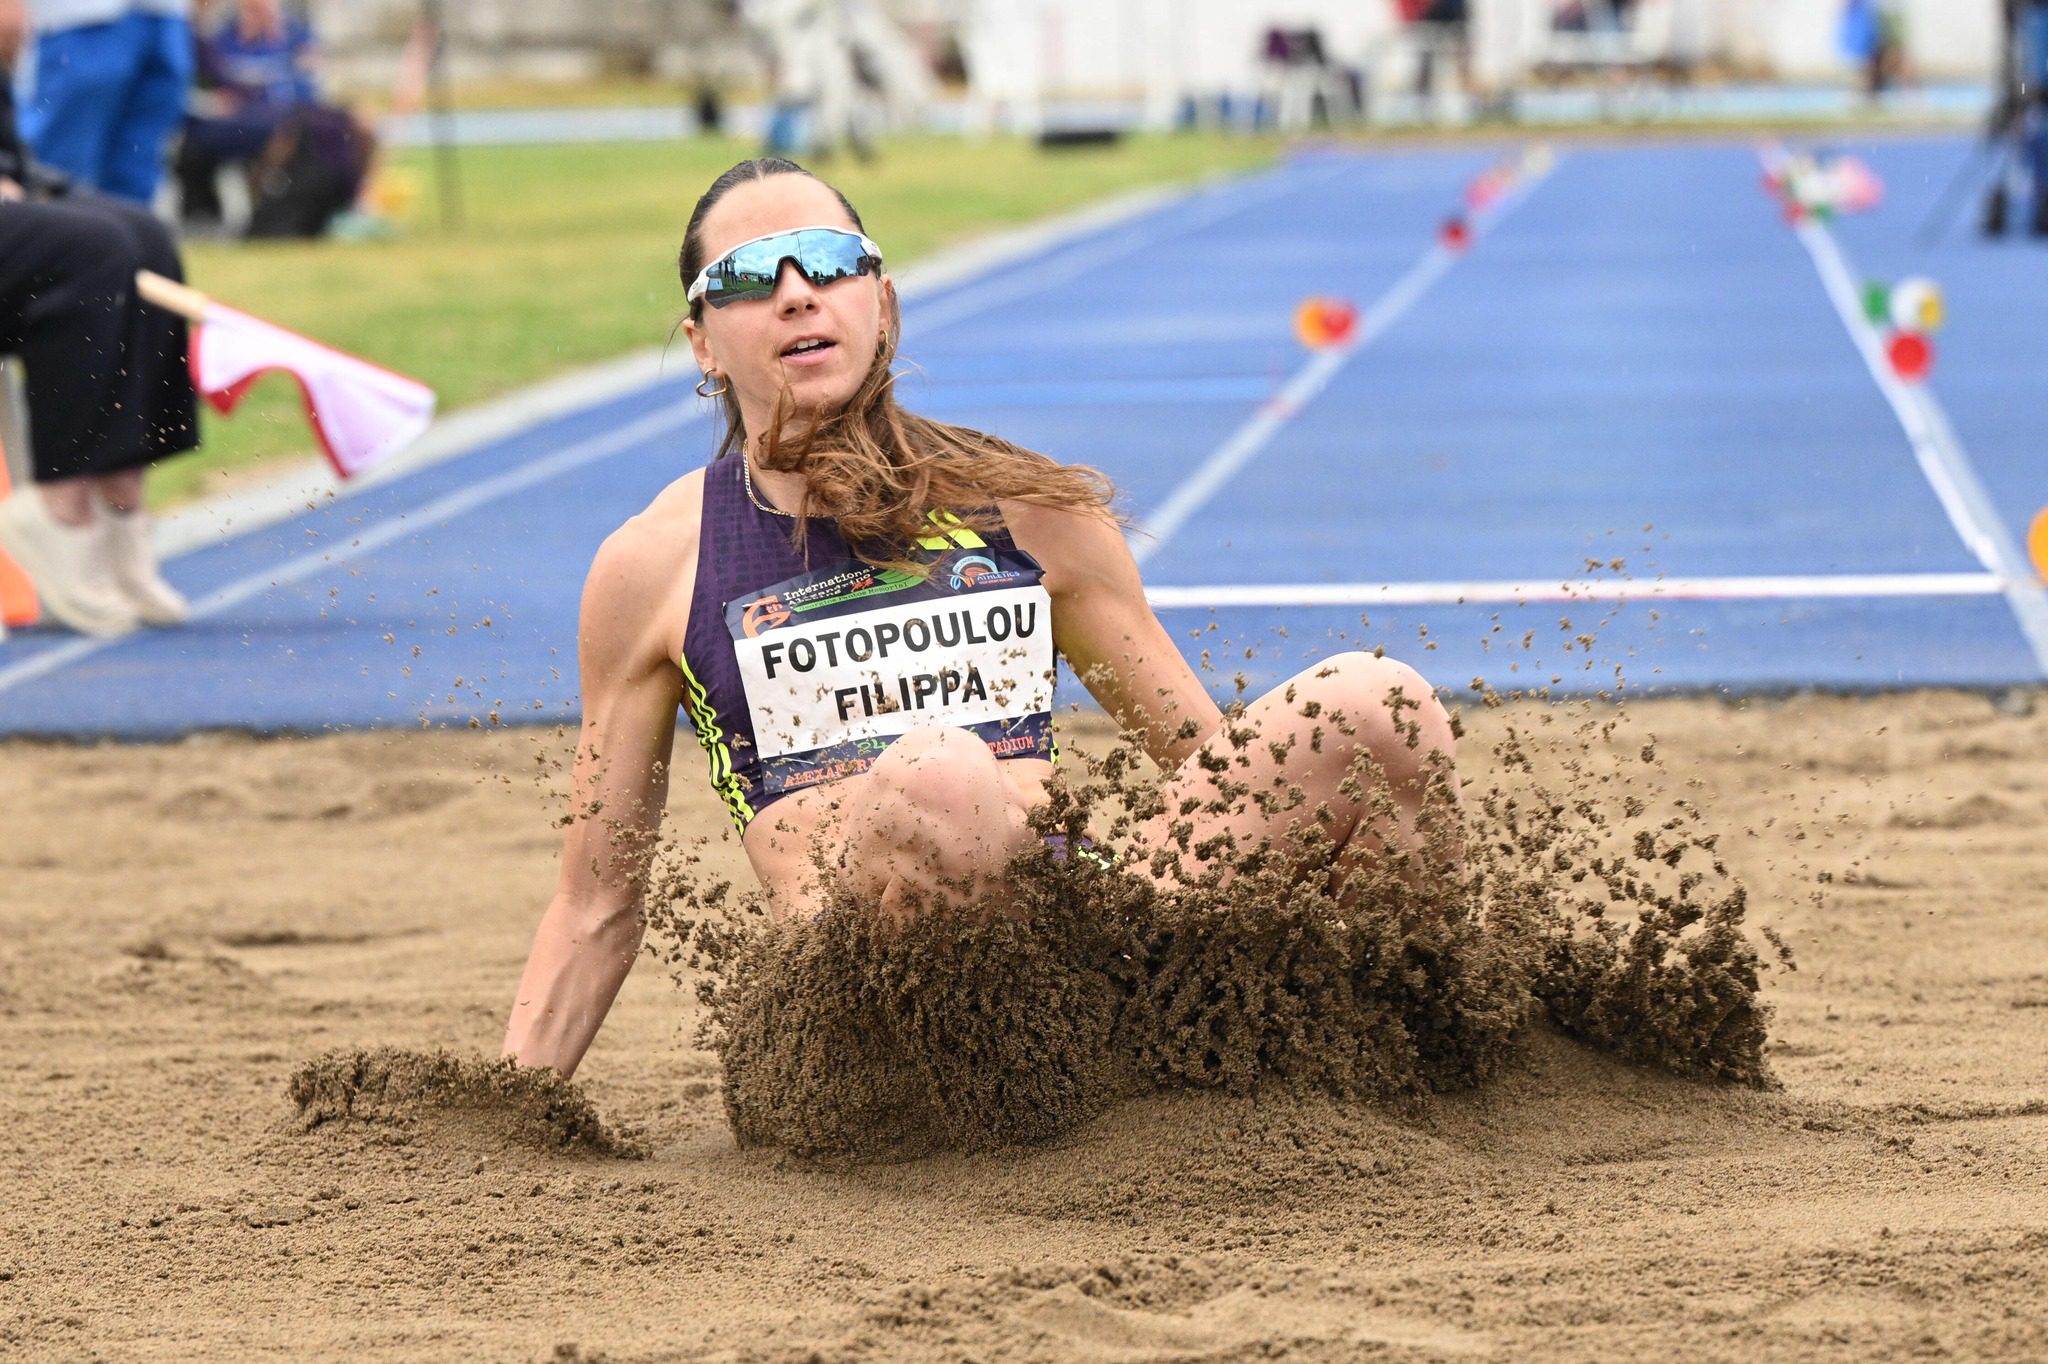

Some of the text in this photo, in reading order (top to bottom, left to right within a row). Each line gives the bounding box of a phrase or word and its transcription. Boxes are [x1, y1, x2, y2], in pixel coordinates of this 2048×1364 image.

[783, 565, 876, 601] International
[868, 581, 909, 594] Memorial
[977, 571, 1020, 581] ATHLETICS
[761, 602, 1036, 679] FOTOPOULOU
[834, 667, 987, 721] FILIPPA
[987, 735, 1035, 755] TADIUM
